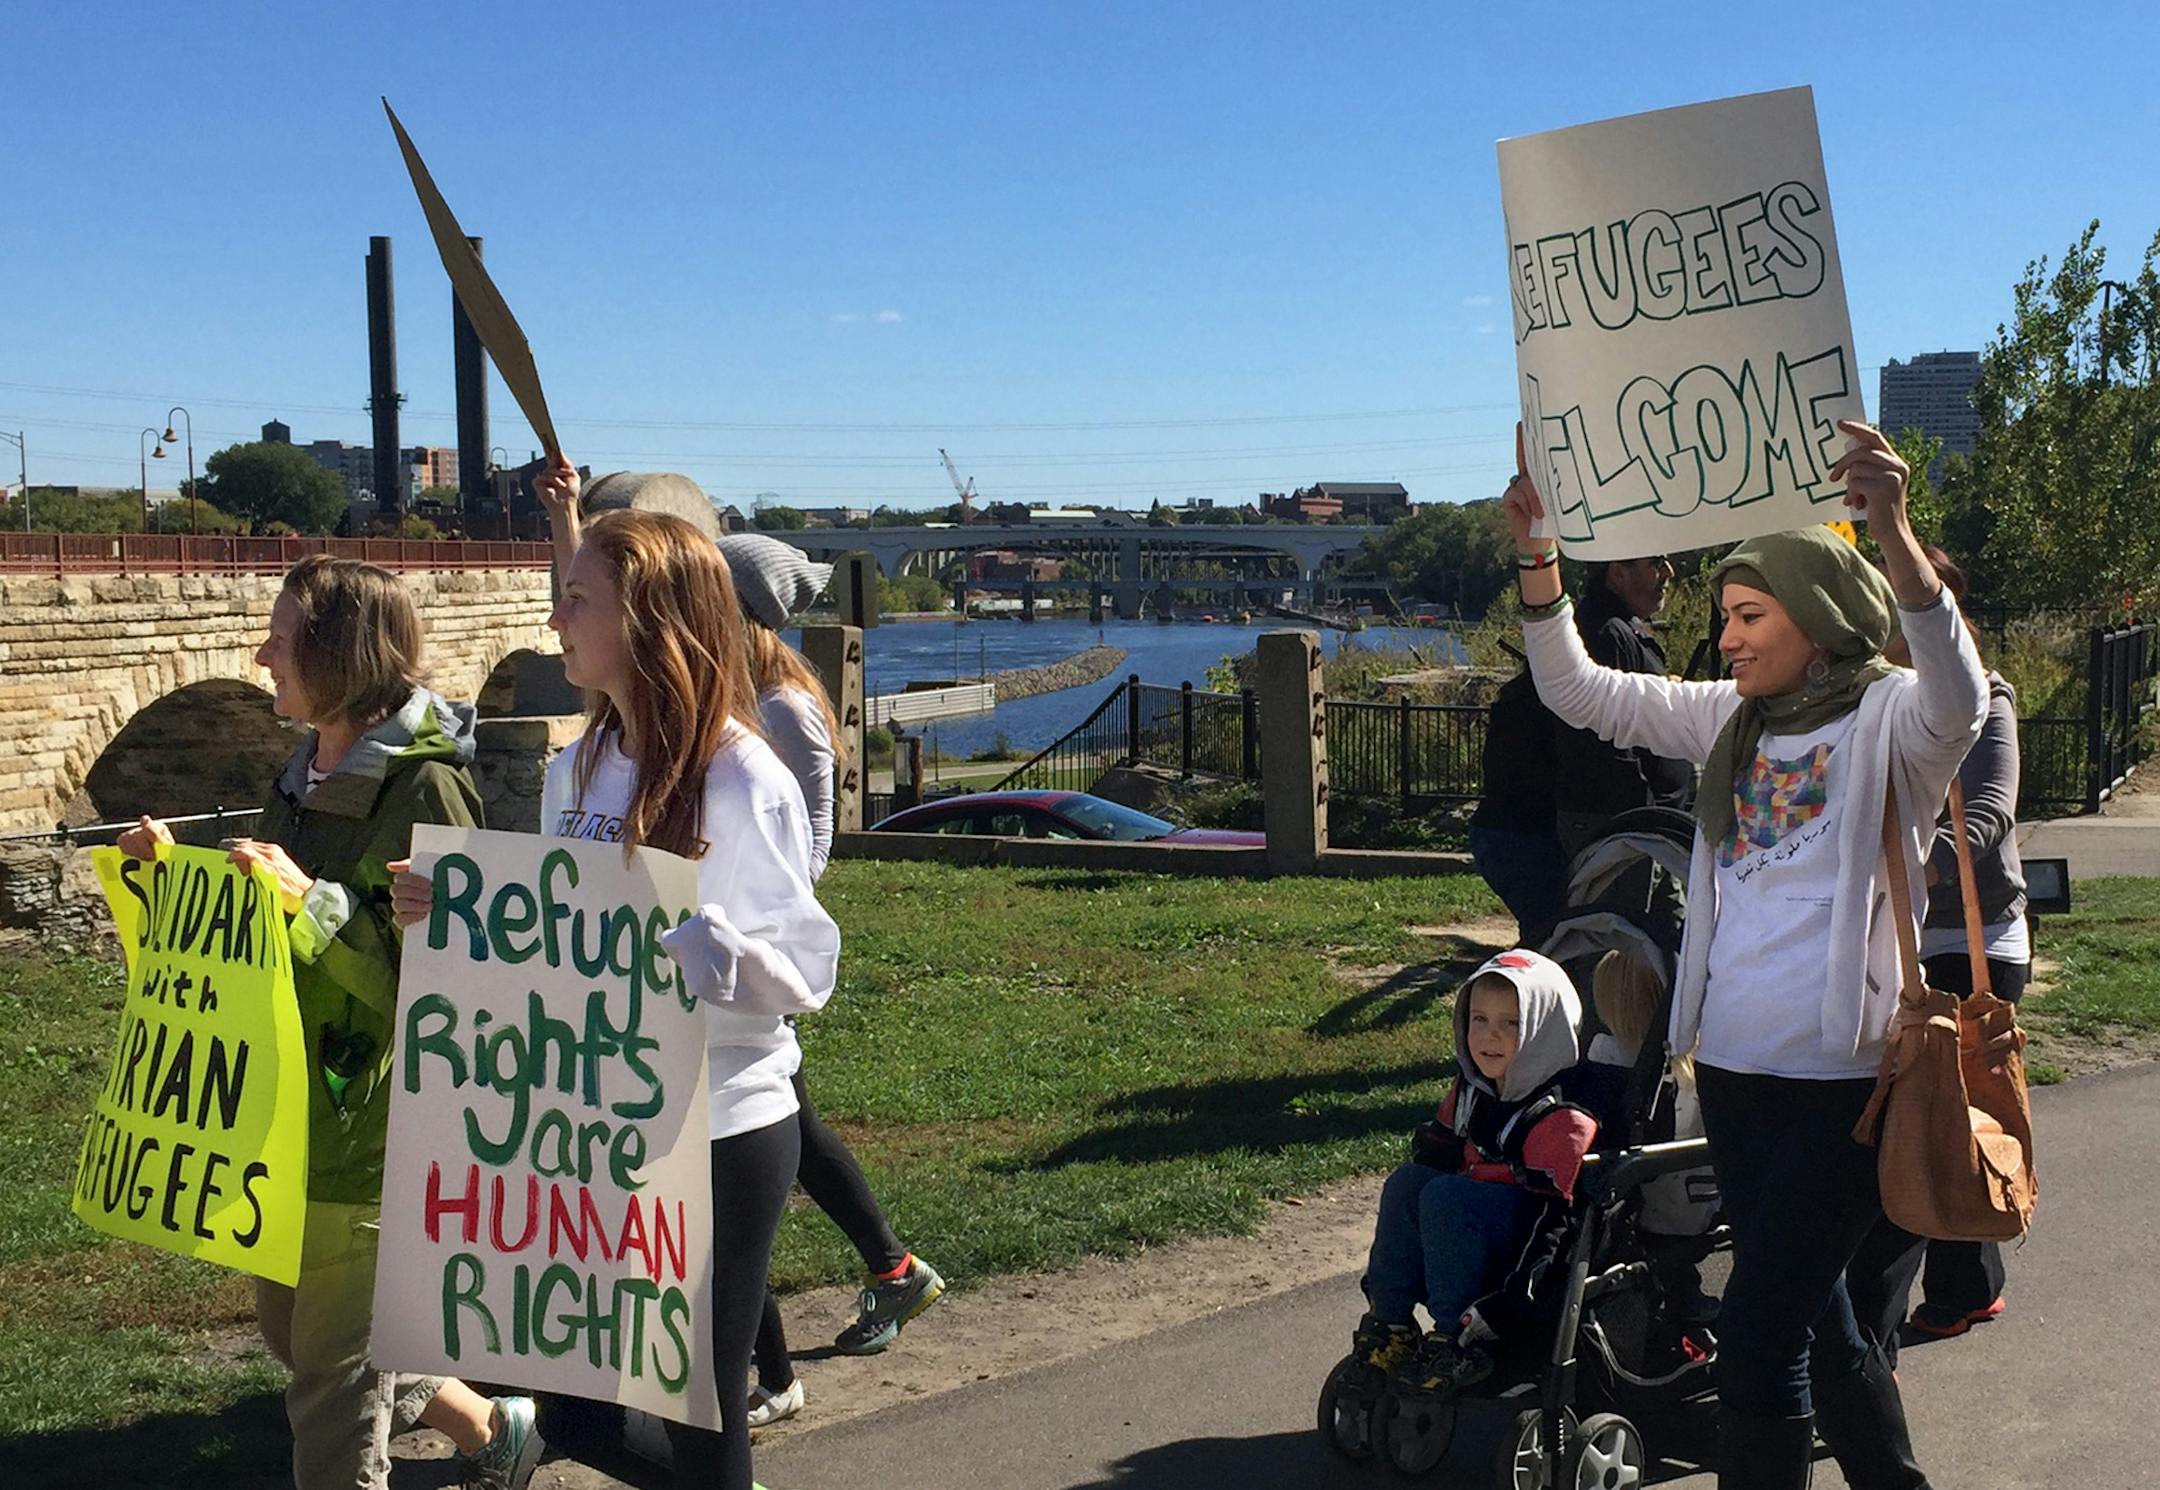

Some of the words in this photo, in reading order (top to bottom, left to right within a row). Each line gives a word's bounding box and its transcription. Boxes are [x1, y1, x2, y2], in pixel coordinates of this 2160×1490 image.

[142, 963, 218, 1012] with
[103, 1010, 248, 1131] YRIAN
[404, 990, 664, 1166] Rights
[530, 1108, 648, 1191] are
[424, 1160, 687, 1285] HUMAN
[442, 1252, 690, 1393] RIGHTS
